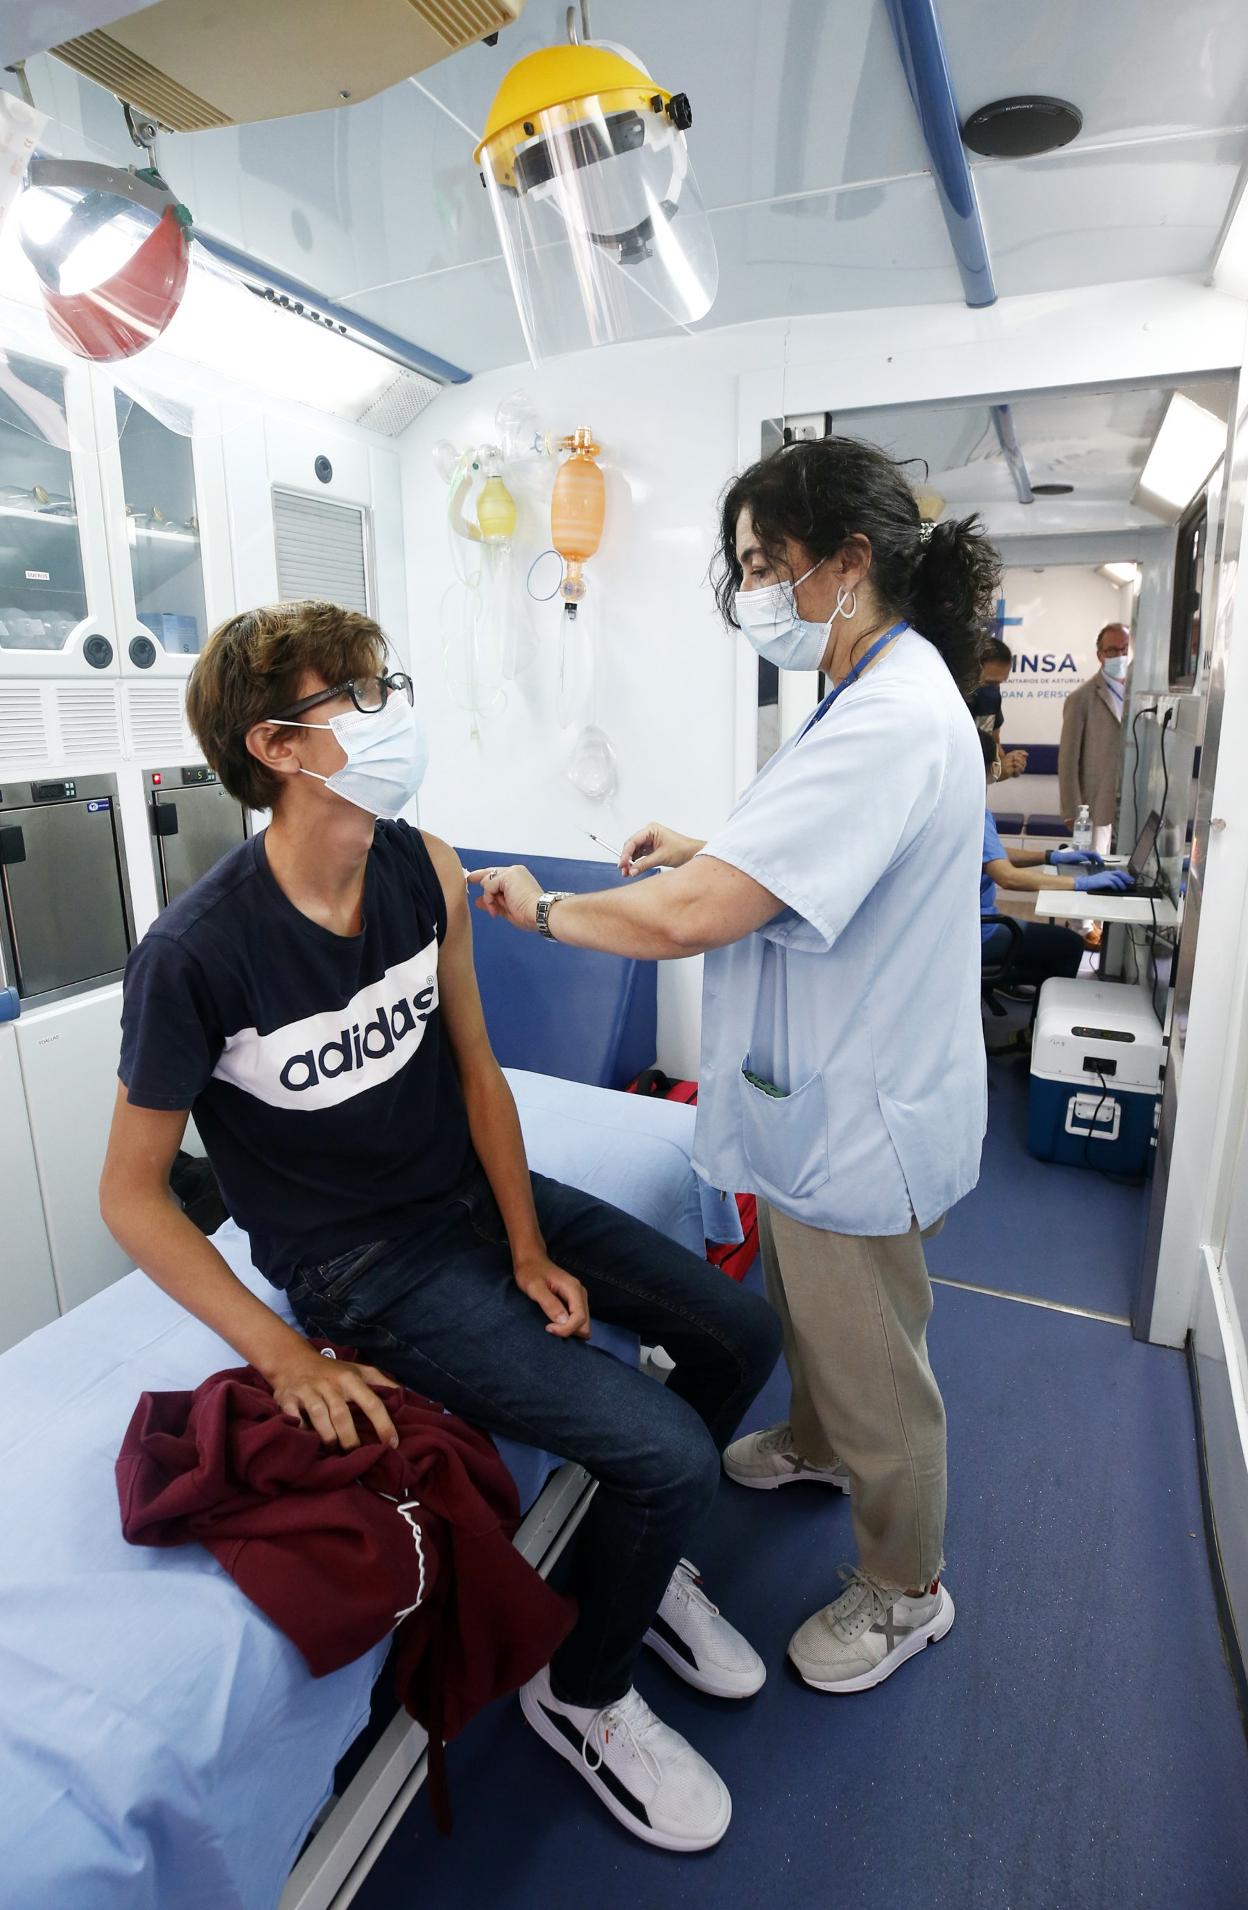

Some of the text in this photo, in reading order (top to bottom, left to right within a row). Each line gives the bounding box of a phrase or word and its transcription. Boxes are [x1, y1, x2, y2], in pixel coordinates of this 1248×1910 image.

[1011, 653, 1077, 673] INSA
[1026, 690, 1034, 698] A
[279, 985, 434, 1092] adidas
